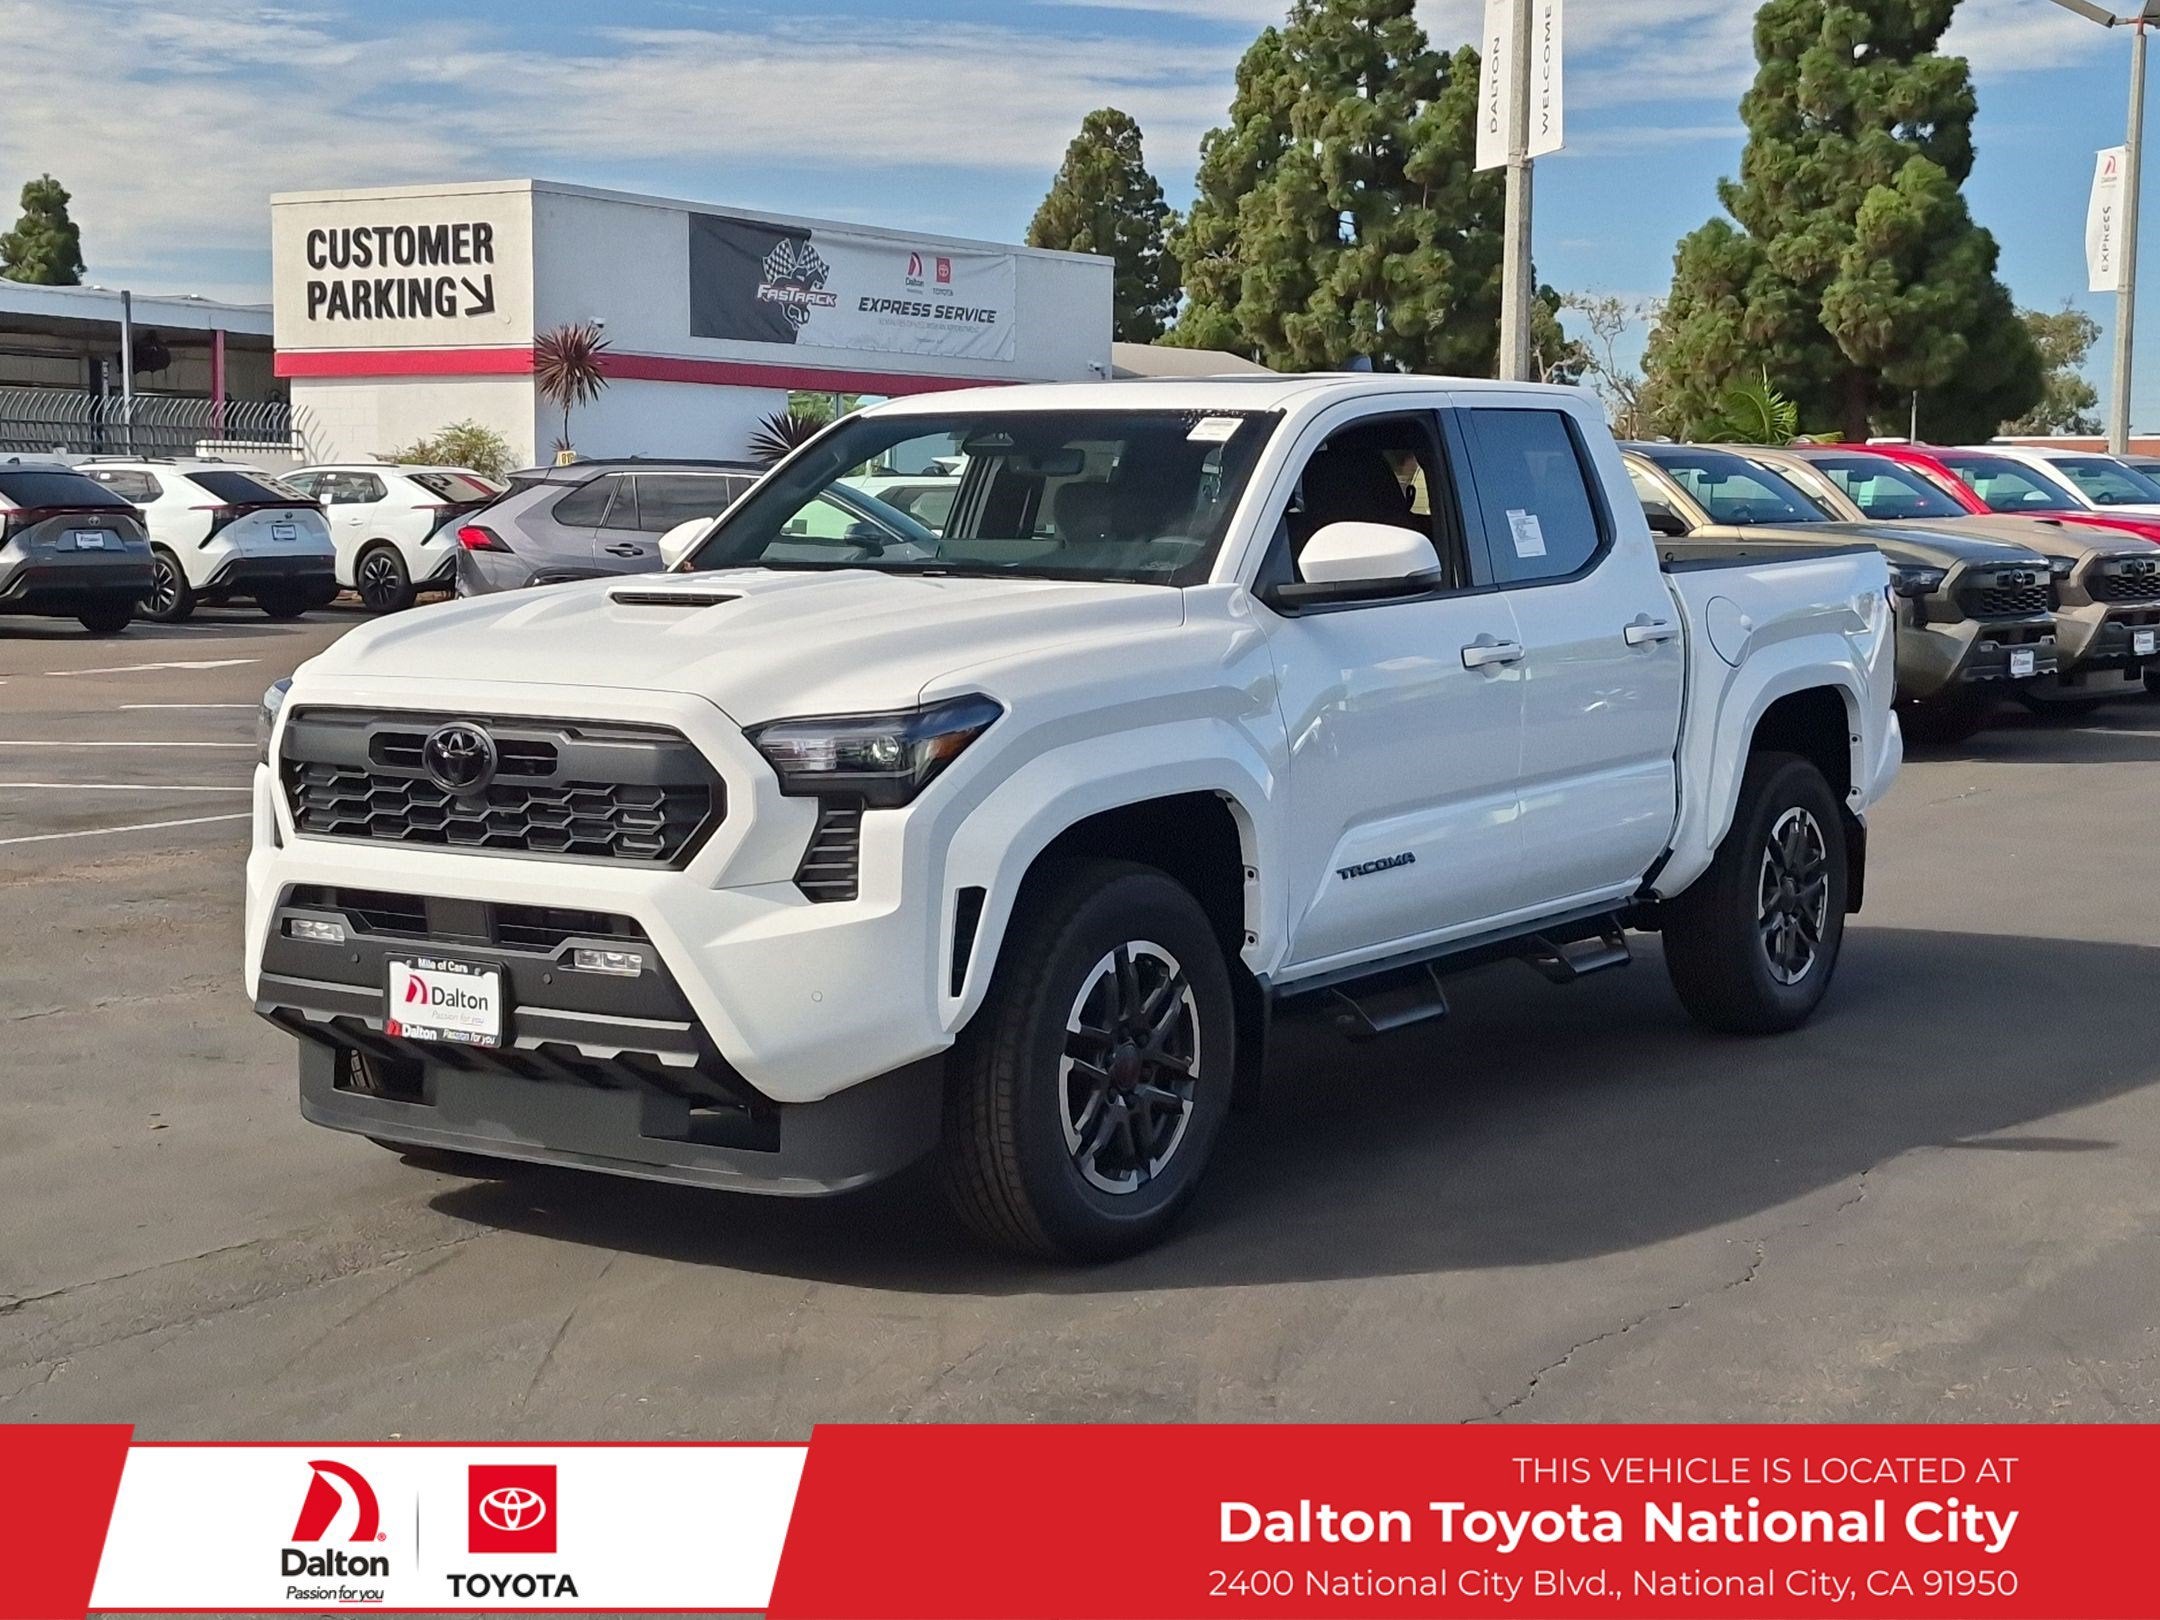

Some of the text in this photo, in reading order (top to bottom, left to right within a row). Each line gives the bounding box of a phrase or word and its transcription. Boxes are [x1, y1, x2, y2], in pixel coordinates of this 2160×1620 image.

[1490, 36, 1500, 134] DALTON
[1542, 5, 1552, 136] WELCOME
[306, 221, 495, 270] CUSTOMER
[306, 276, 458, 321] PARKING
[932, 287, 954, 297] TOYOTA
[858, 296, 997, 324] EXPRESS SERVICE
[1336, 851, 1416, 881] TACOMA
[431, 986, 489, 1011] Dalton
[401, 1023, 438, 1041] Dalton
